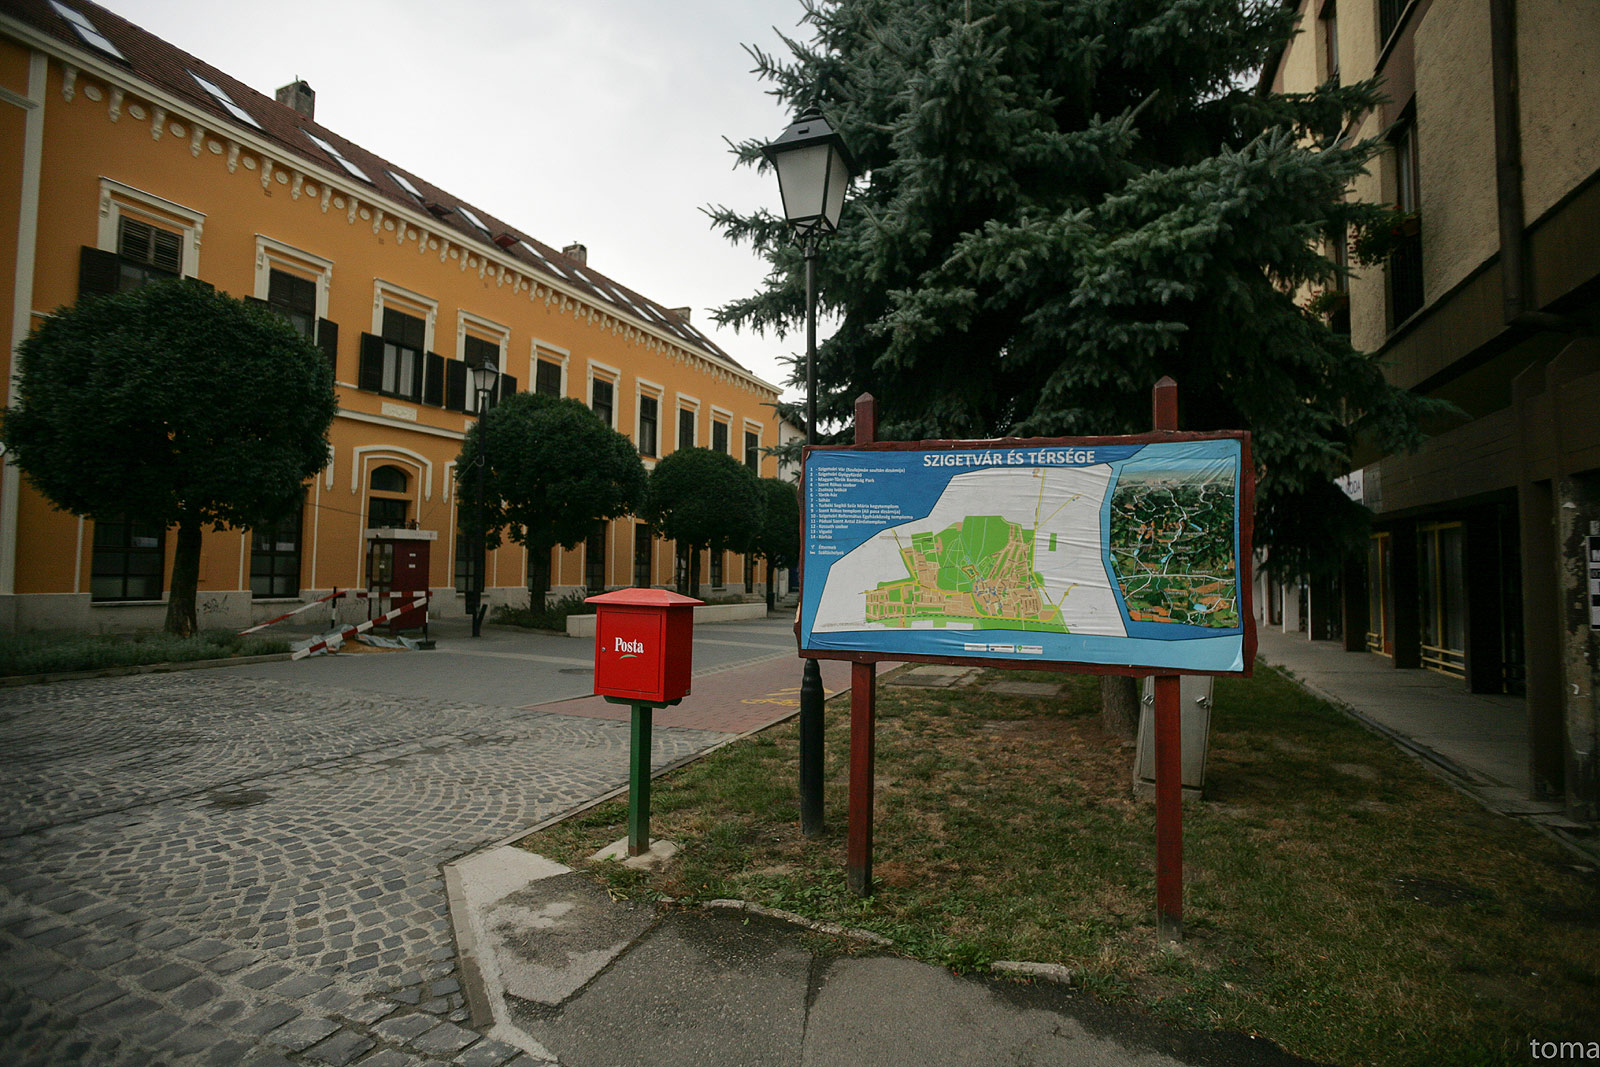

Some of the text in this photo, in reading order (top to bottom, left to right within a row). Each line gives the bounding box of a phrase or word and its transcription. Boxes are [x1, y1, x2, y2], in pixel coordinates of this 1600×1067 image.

[923, 448, 1095, 466] SZIGETVÁR ÉS TÉRSÉGE
[615, 637, 644, 654] Posta
